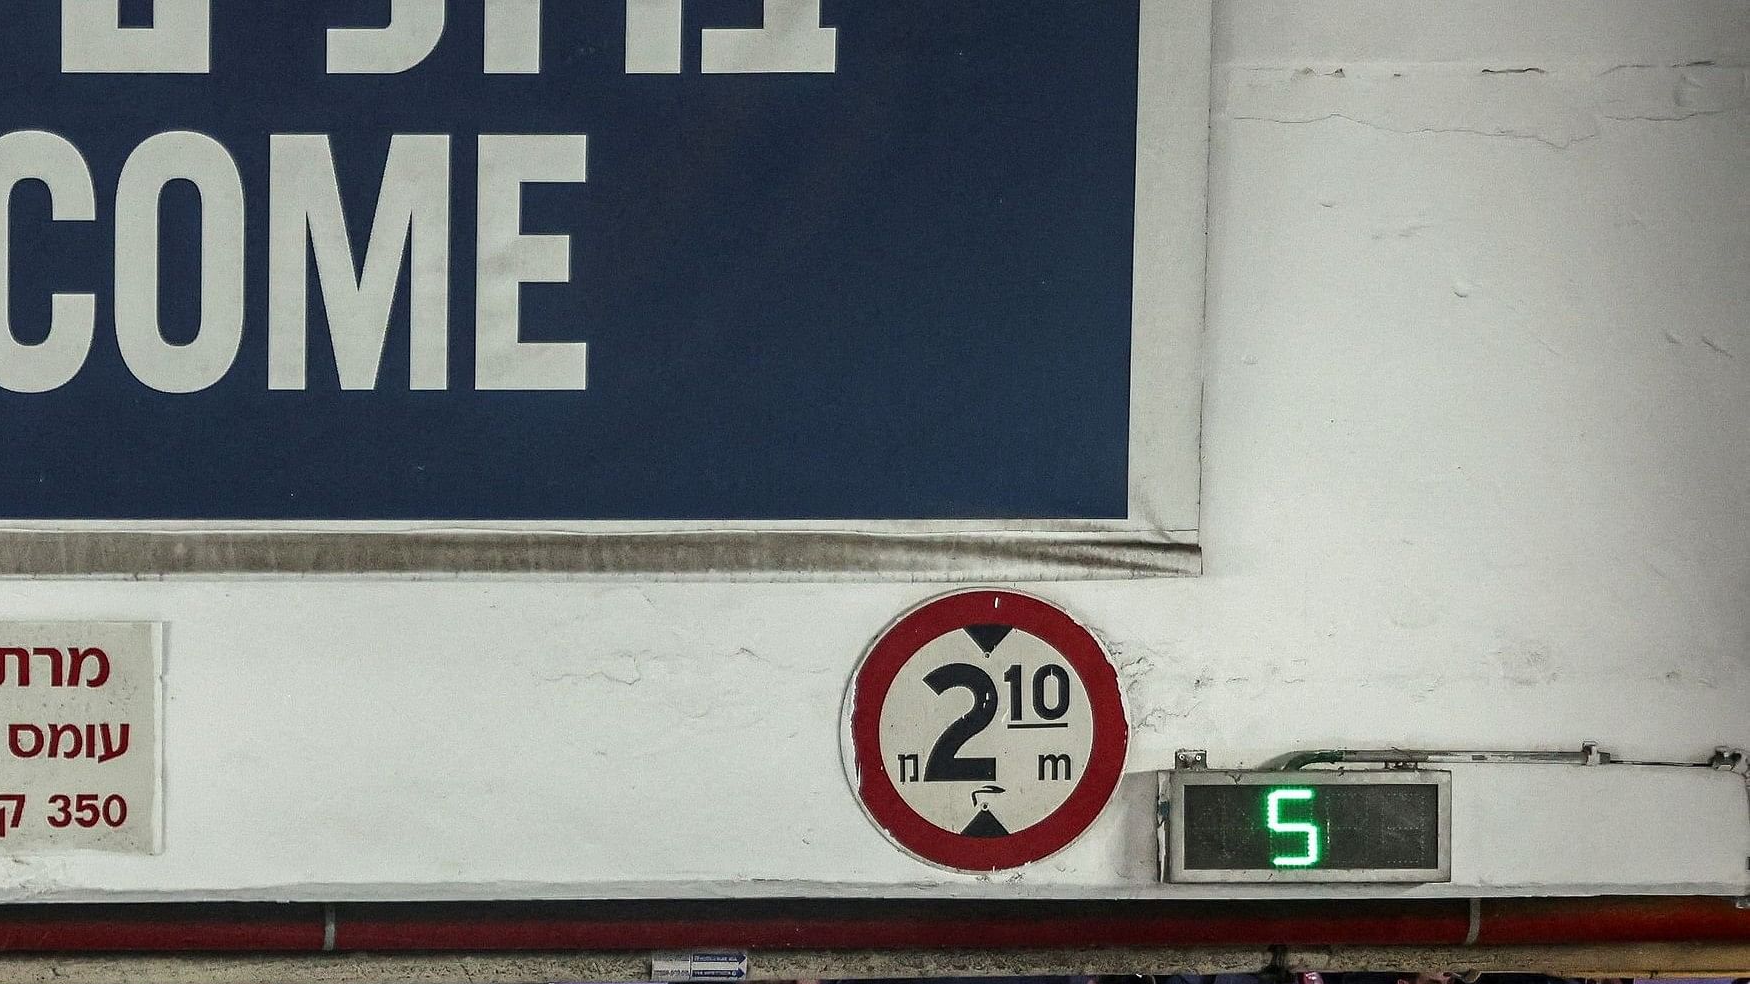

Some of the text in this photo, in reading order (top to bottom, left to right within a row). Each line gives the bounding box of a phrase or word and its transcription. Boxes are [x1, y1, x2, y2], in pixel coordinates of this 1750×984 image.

[922, 662, 1071, 782] 2 10
[7, 723, 131, 764] עומס
[1038, 753, 1072, 781] m
[47, 794, 128, 829] 350
[1266, 787, 1319, 868] 5
